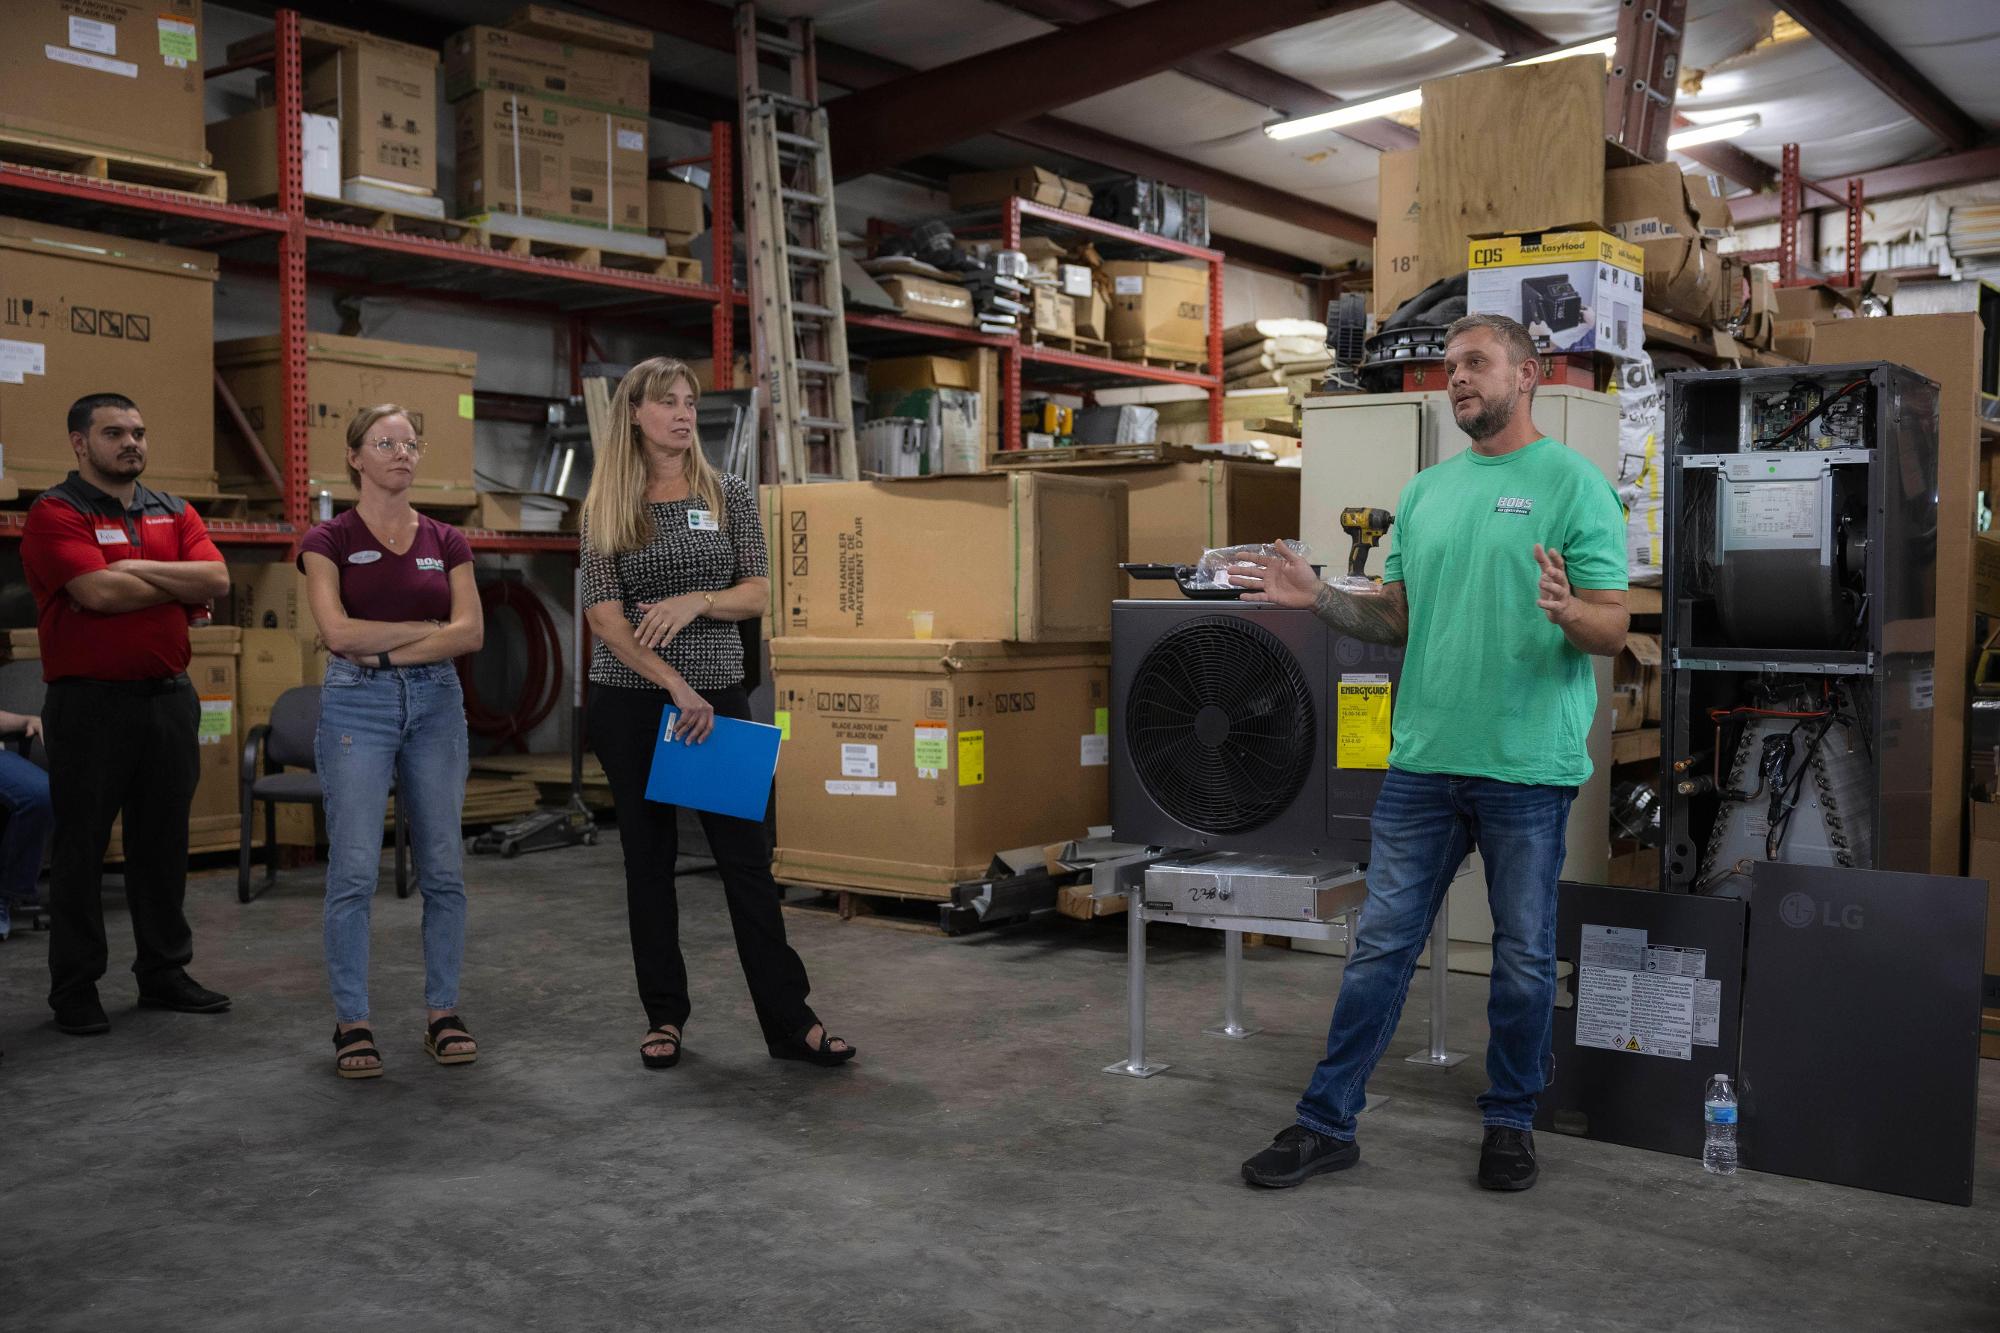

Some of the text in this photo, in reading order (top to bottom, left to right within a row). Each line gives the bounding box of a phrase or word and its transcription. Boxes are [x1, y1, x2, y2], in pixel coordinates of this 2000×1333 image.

[1542, 241, 1585, 254] EasyHood
[1391, 254, 1420, 273] 18"
[1497, 497, 1533, 508] BOBS
[839, 532, 848, 613] AIR HANDLER
[847, 534, 856, 611] APPAREIL DE
[855, 553, 865, 628] TRAITEMENT
[1822, 900, 1865, 929] LG
